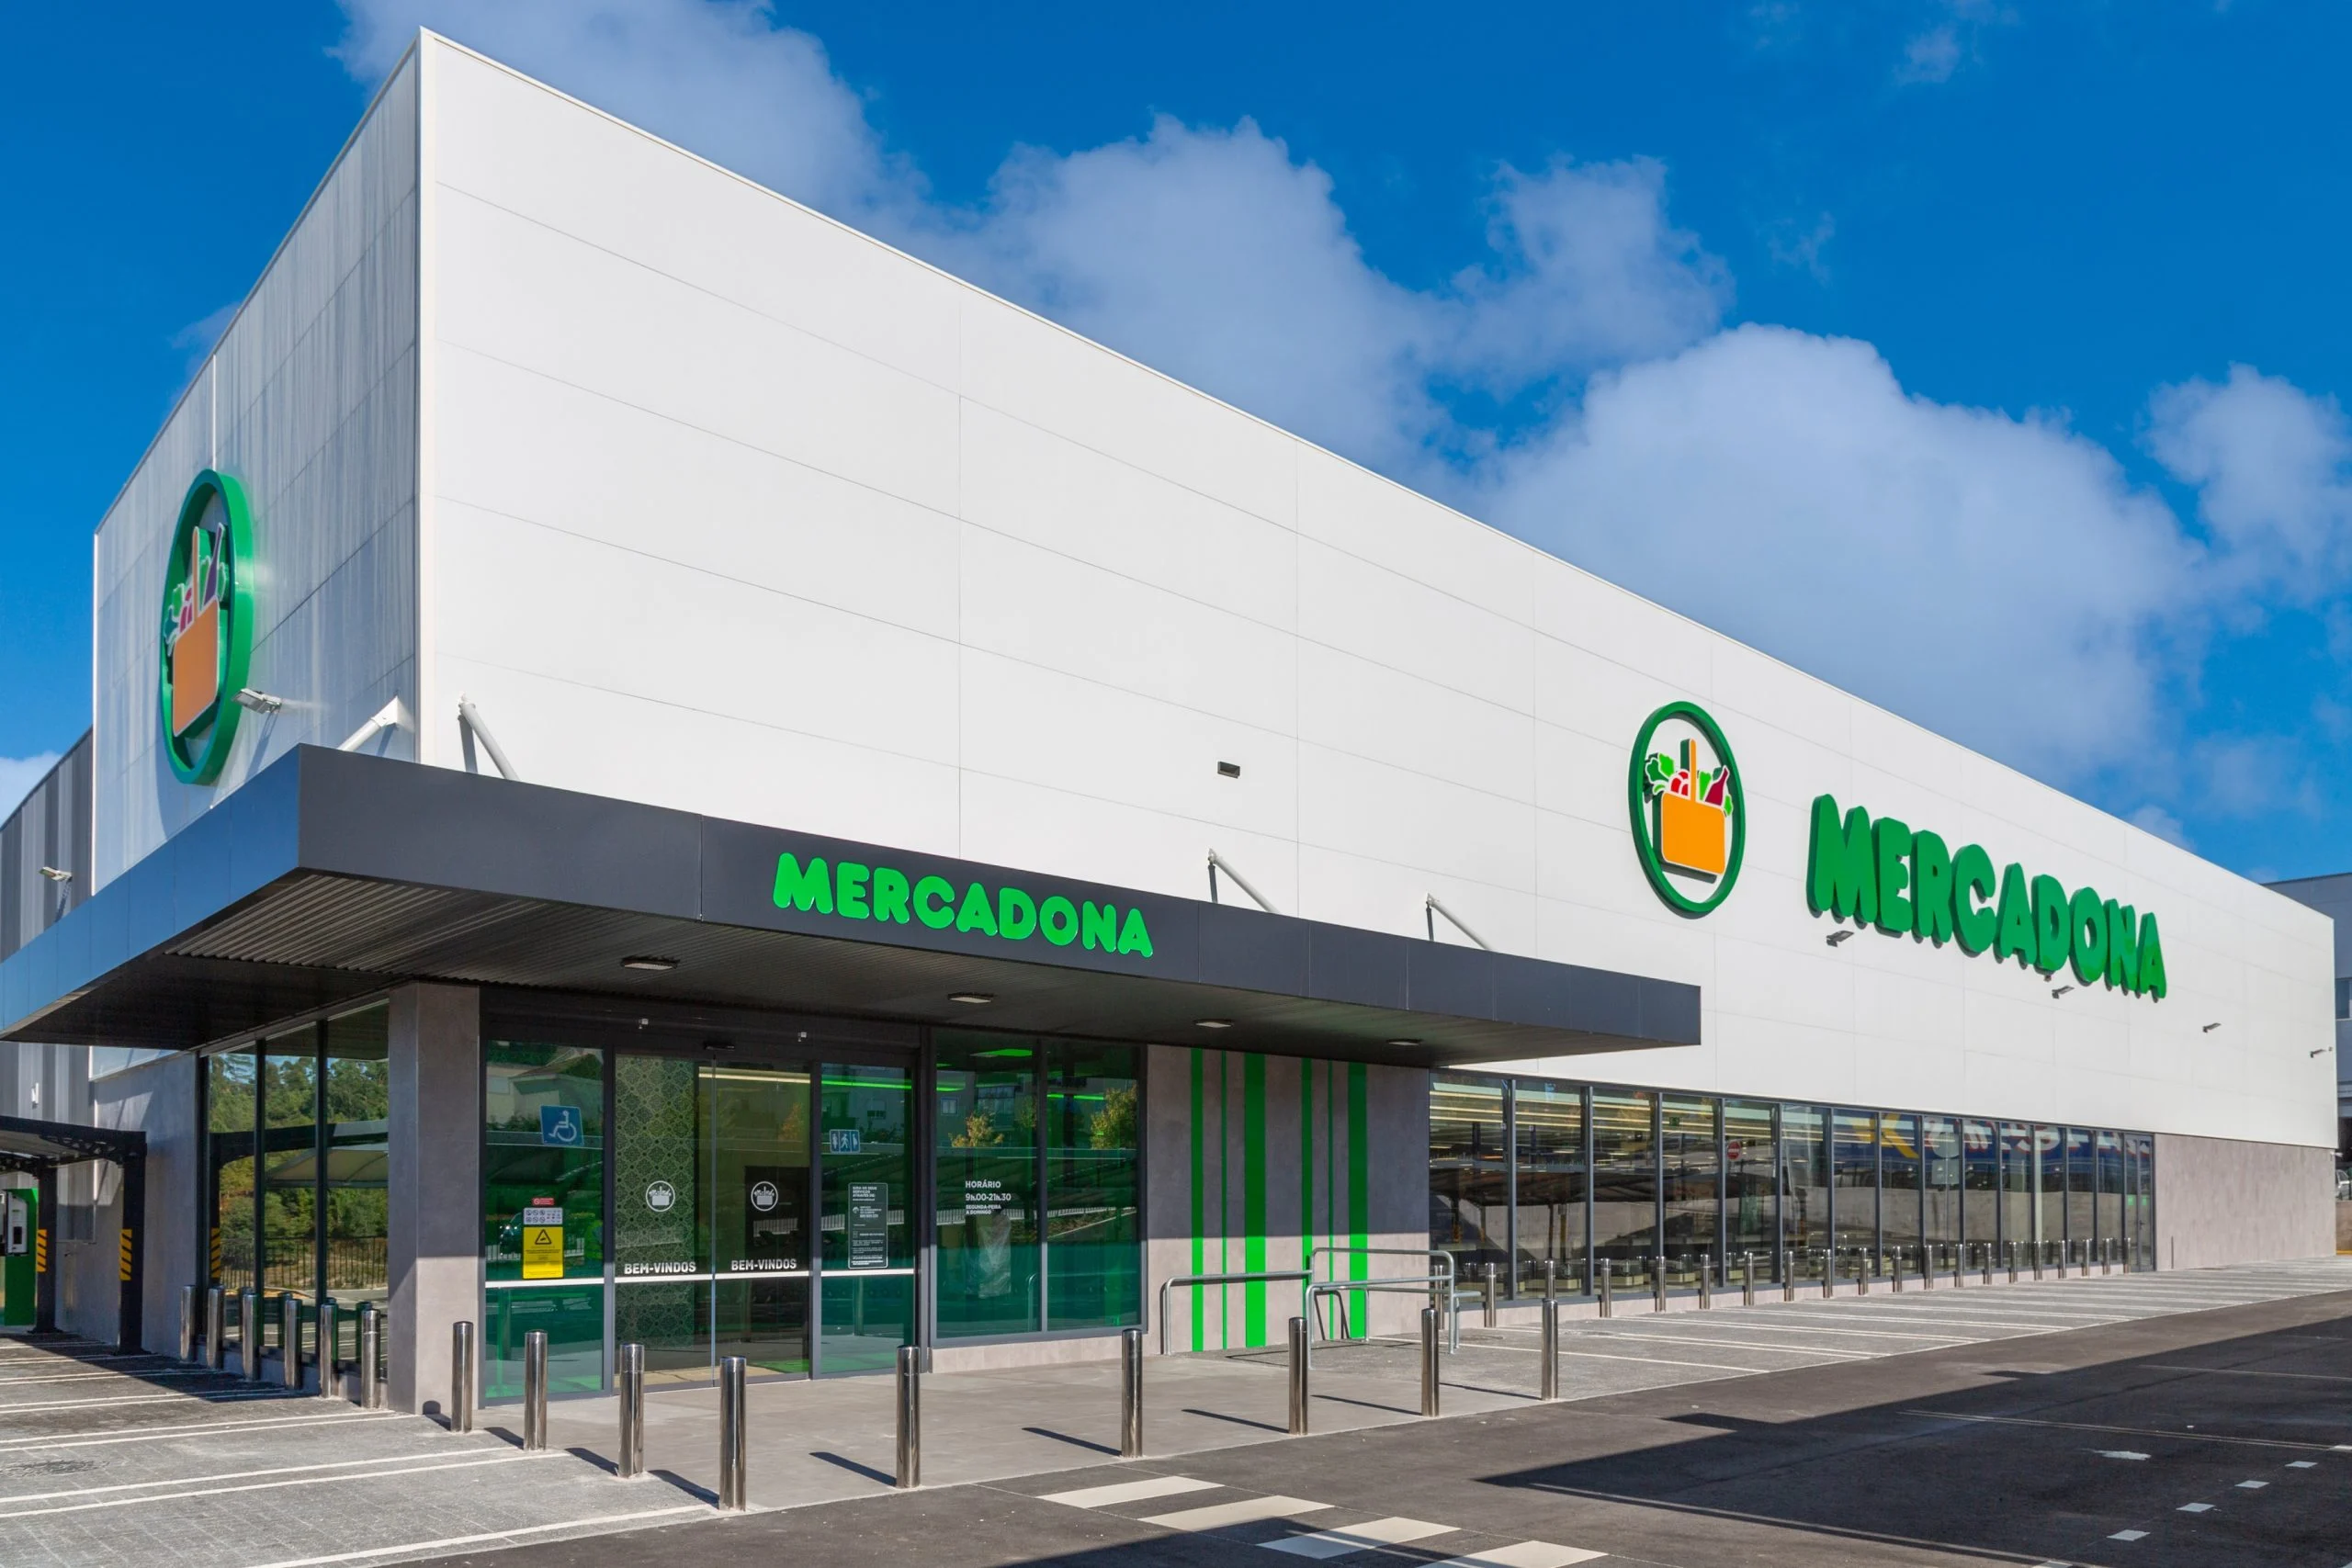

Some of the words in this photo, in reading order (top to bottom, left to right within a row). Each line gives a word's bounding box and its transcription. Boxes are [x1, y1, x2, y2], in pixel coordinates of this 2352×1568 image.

[1806, 794, 2166, 1001] MERCADONA
[773, 852, 1153, 957] MERCADONA
[965, 1179, 1001, 1188] HORÁRIO
[625, 1262, 696, 1274] BEM-VINDOS
[731, 1258, 797, 1270] BEM-VINDOS
